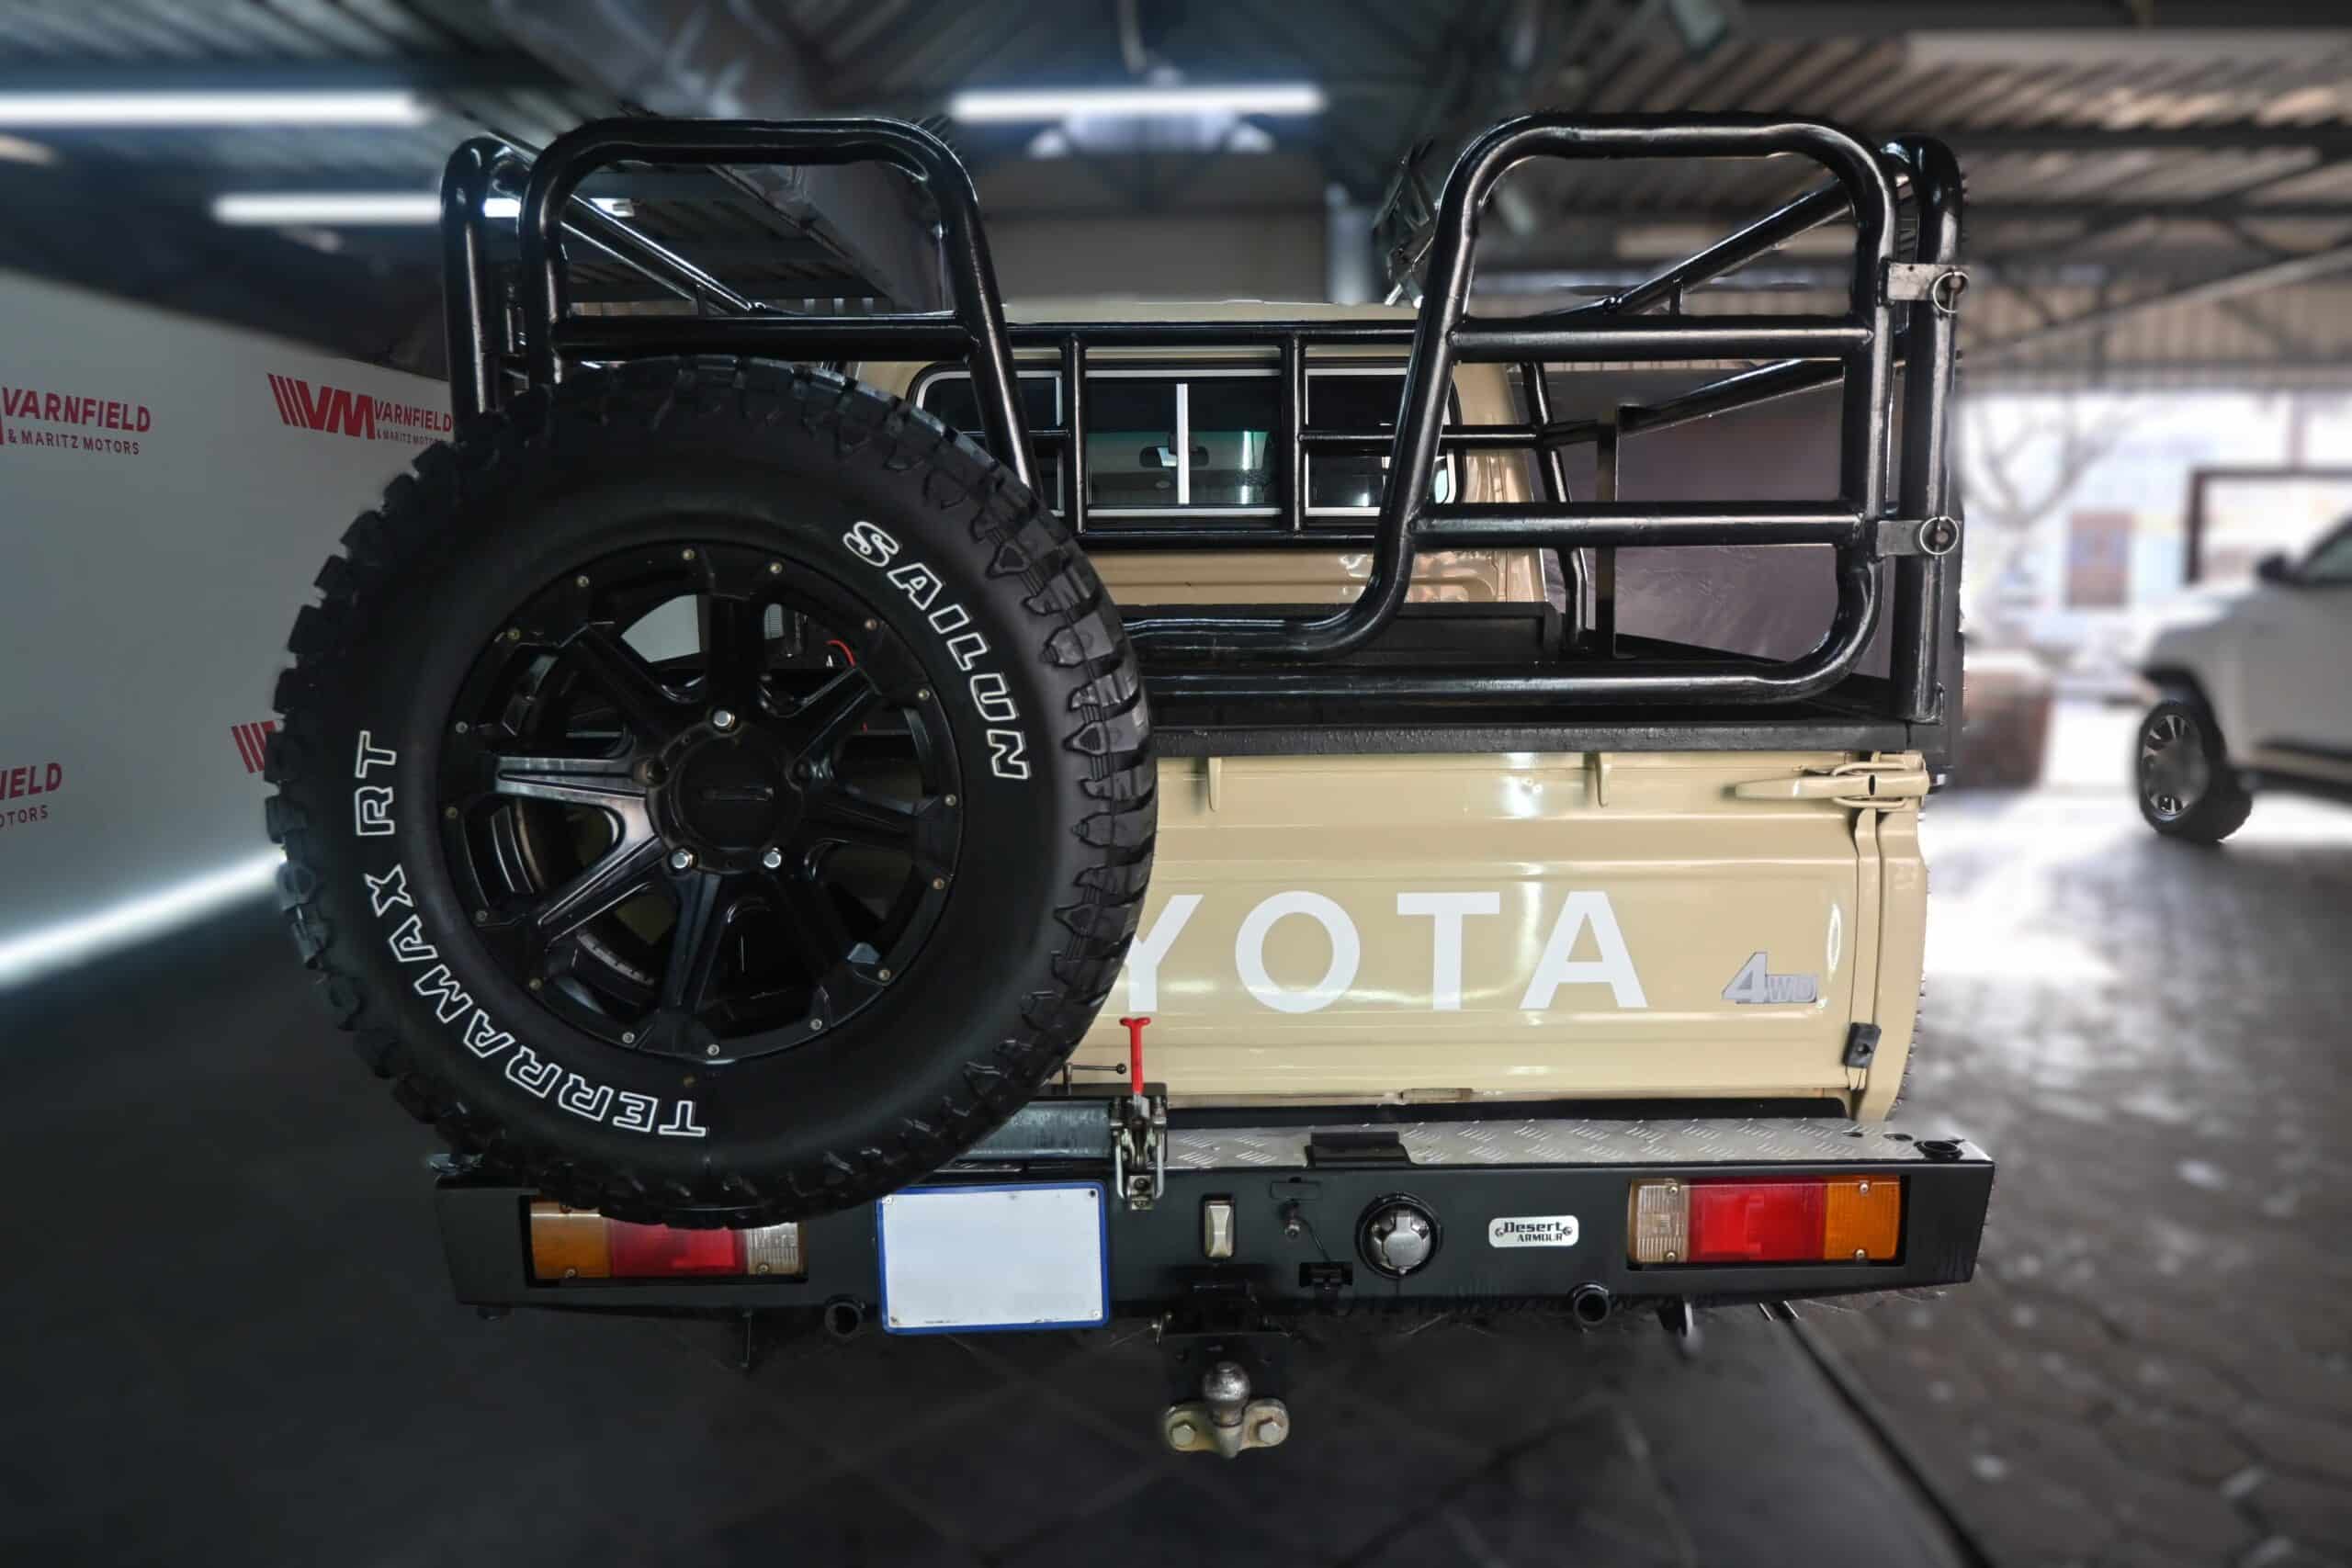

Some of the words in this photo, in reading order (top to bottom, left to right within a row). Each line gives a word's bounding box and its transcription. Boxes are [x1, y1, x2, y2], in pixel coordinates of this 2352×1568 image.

[2, 387, 152, 433] VARNFIELD
[374, 400, 452, 433] VARNFIELD
[7, 428, 17, 444] &
[21, 429, 79, 449] MARITZ
[83, 436, 141, 455] MOTORS
[842, 521, 1031, 780] SAILUN
[355, 731, 396, 836] RT
[365, 863, 707, 1136] TERRAMAX
[1721, 952, 1817, 1003] 4WD
[1504, 1221, 1563, 1234] Desert
